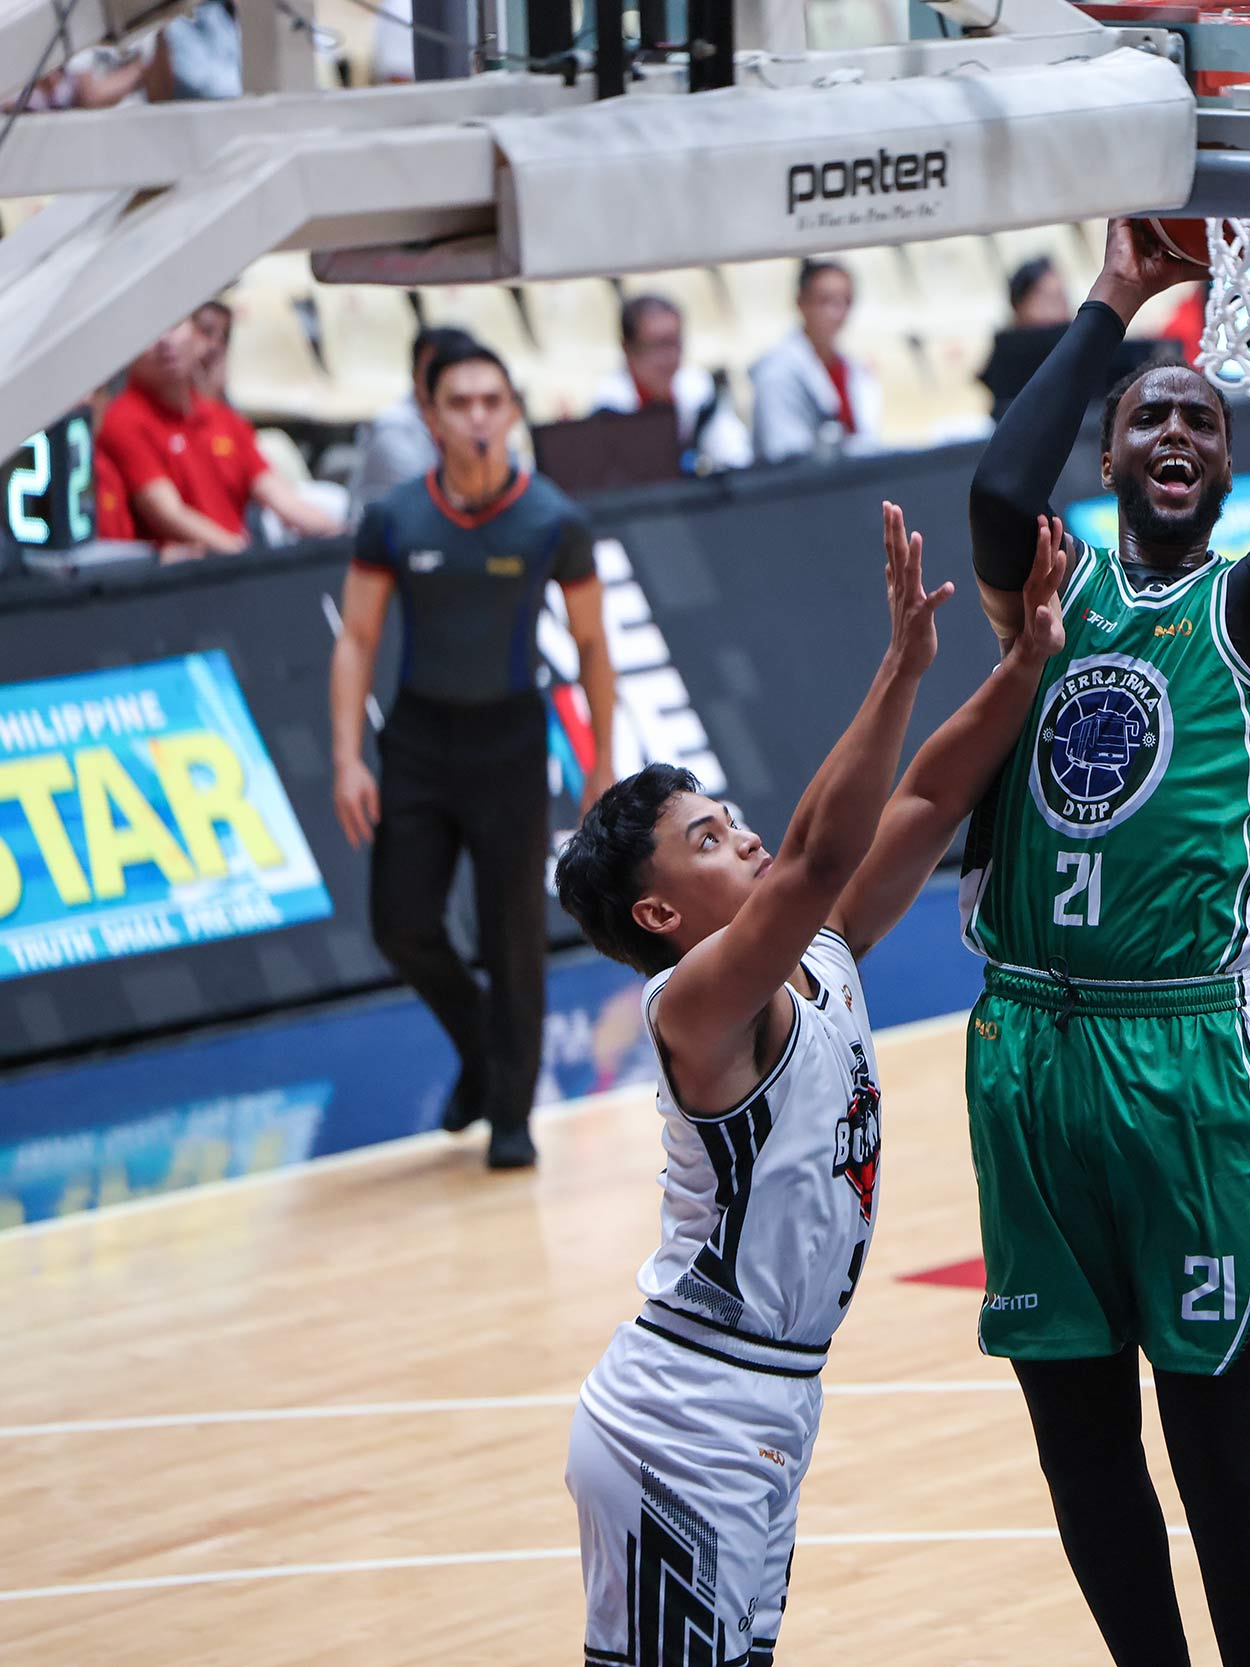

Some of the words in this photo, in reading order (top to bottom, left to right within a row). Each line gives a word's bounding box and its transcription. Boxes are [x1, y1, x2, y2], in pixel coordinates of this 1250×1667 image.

[0, 689, 166, 752] HILIPPINE
[1060, 669, 1159, 713] TERRAIRMA
[1062, 798, 1111, 822] DYIP
[1053, 850, 1103, 927] 21
[1181, 1255, 1236, 1321] 21
